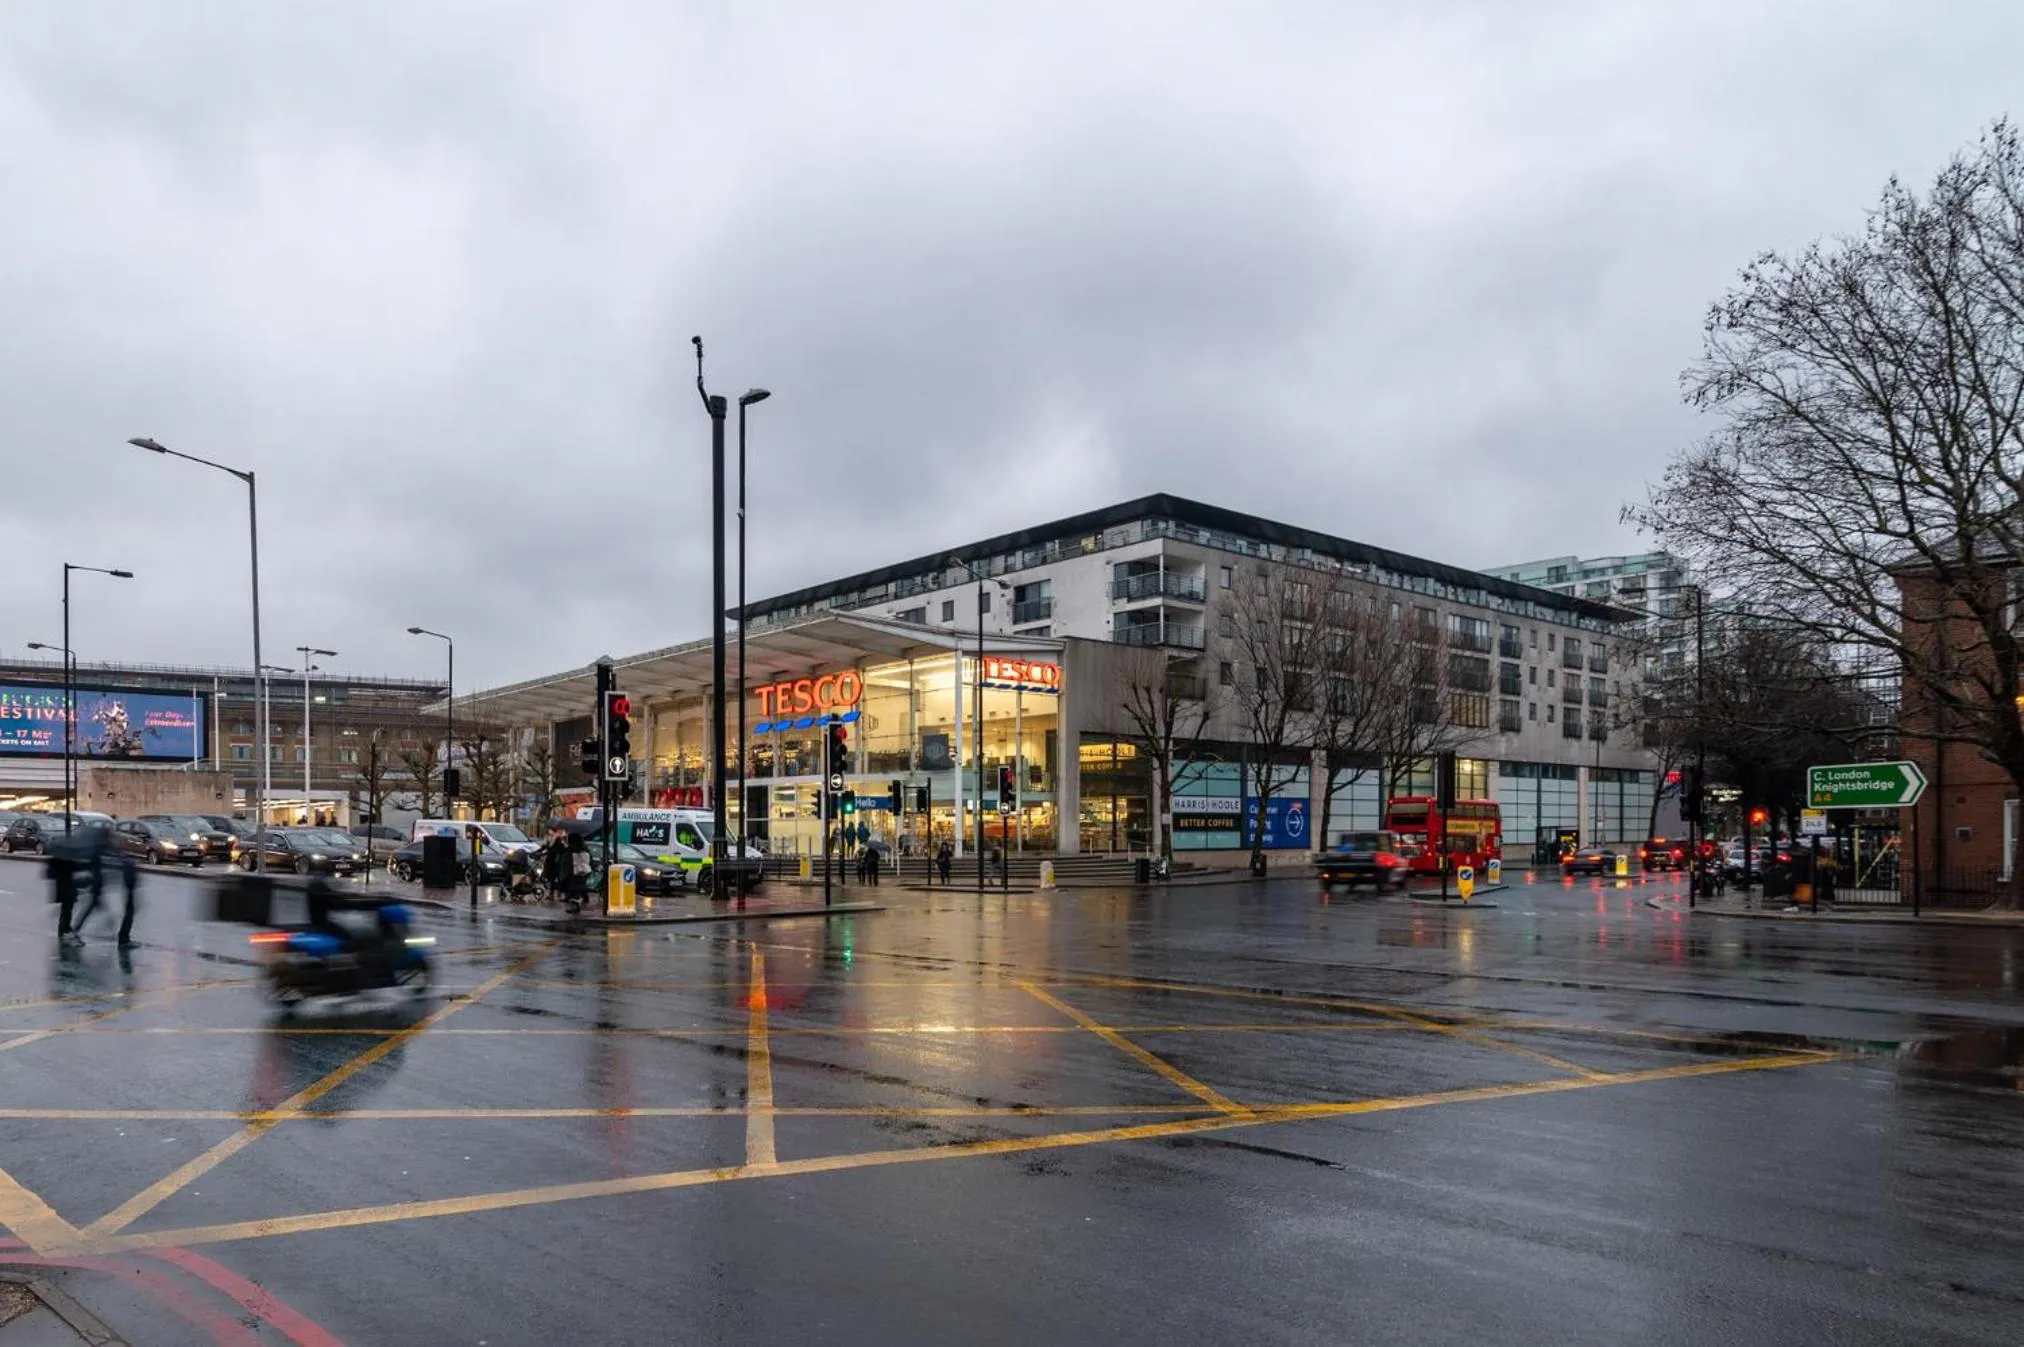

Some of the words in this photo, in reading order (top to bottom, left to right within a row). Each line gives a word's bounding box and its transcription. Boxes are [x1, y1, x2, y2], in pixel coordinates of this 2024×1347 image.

[984, 656, 1060, 684] TESCO
[754, 669, 862, 716] TESCO
[1814, 771, 1826, 781] C.
[1828, 770, 1871, 780] London
[1813, 780, 1895, 793] Knightsbridge
[855, 797, 876, 807] Hello
[1814, 792, 1832, 802] A4
[1174, 799, 1206, 810] HARRIS
[1211, 800, 1240, 810] HOOLE
[621, 811, 672, 820] AMBULANCE
[1180, 818, 1205, 828] BETTER
[1207, 818, 1233, 828] COFFEE
